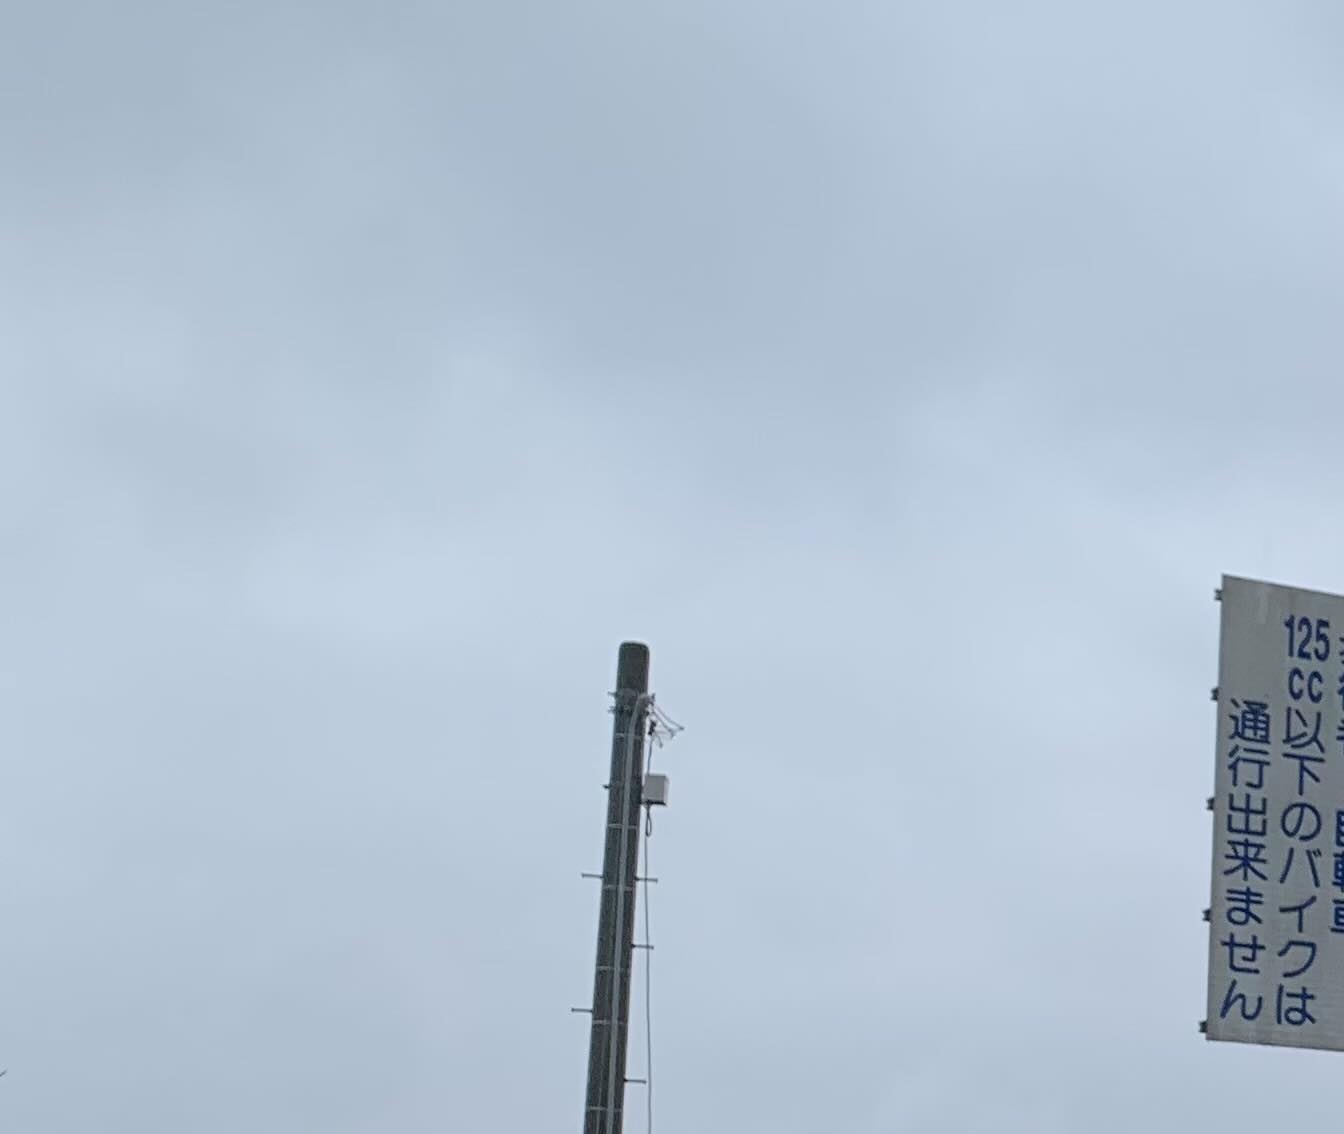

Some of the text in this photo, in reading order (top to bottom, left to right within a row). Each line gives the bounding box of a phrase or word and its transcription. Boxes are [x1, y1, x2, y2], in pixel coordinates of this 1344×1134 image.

[1220, 698, 1271, 1022] 通行出来ません
